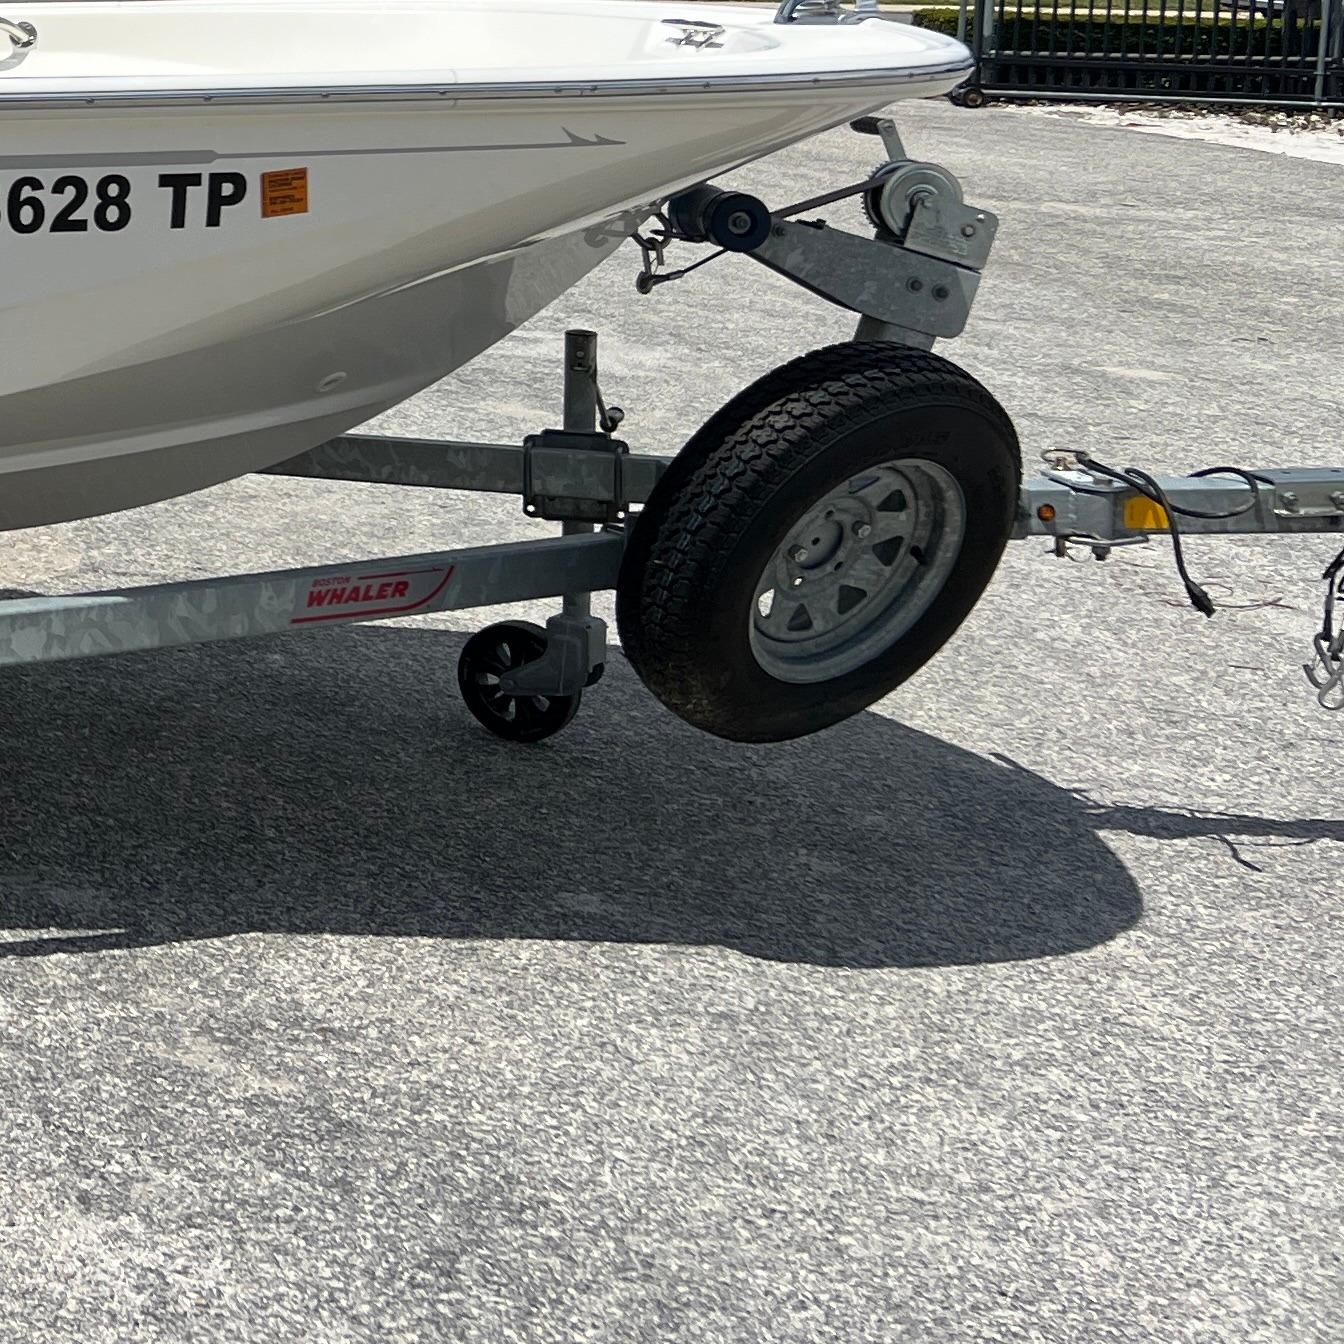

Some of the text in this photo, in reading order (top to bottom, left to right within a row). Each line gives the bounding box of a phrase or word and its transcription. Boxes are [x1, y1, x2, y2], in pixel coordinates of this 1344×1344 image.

[158, 171, 248, 229] TP
[307, 581, 409, 607] WHALER
[312, 576, 350, 587] BOSTON
